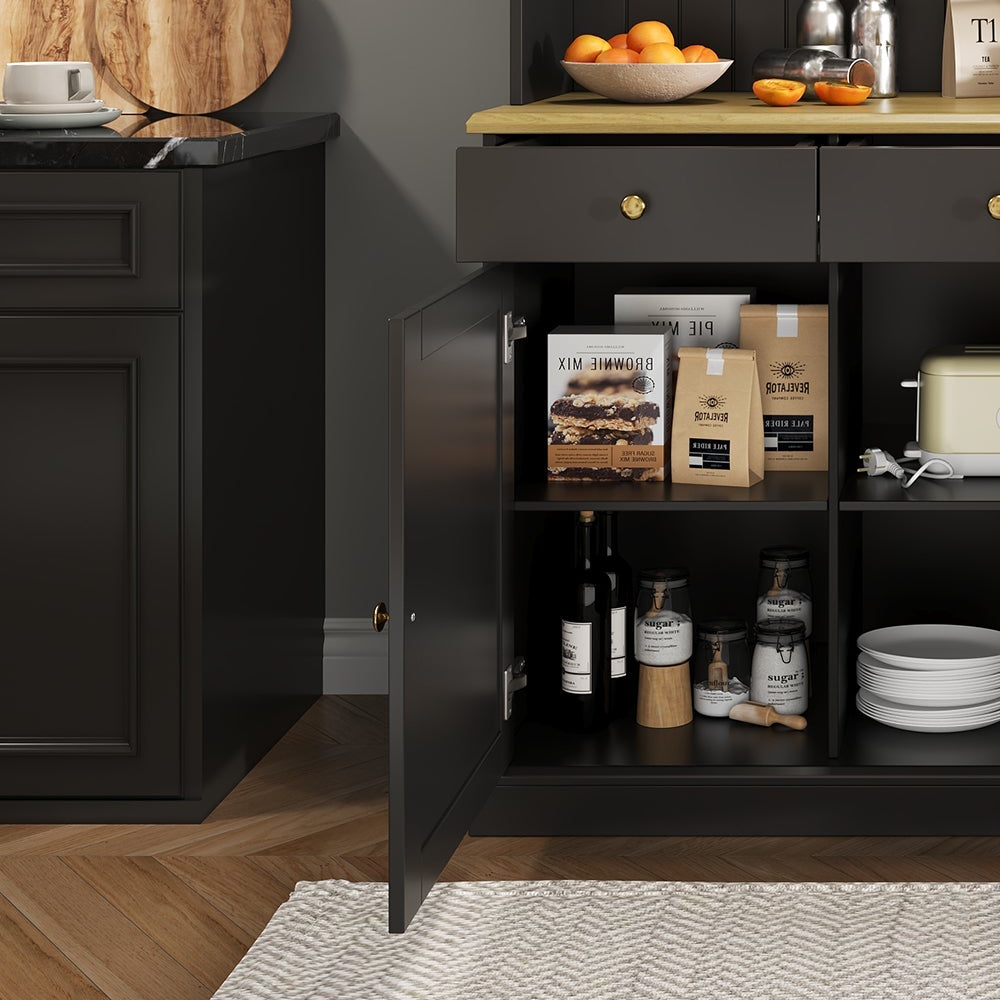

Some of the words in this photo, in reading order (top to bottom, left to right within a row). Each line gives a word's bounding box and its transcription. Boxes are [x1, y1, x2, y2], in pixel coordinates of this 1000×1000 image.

[971, 18, 998, 43] T1
[767, 599, 795, 608] sugar
[644, 620, 674, 630] sugar
[767, 673, 799, 684] sugar
